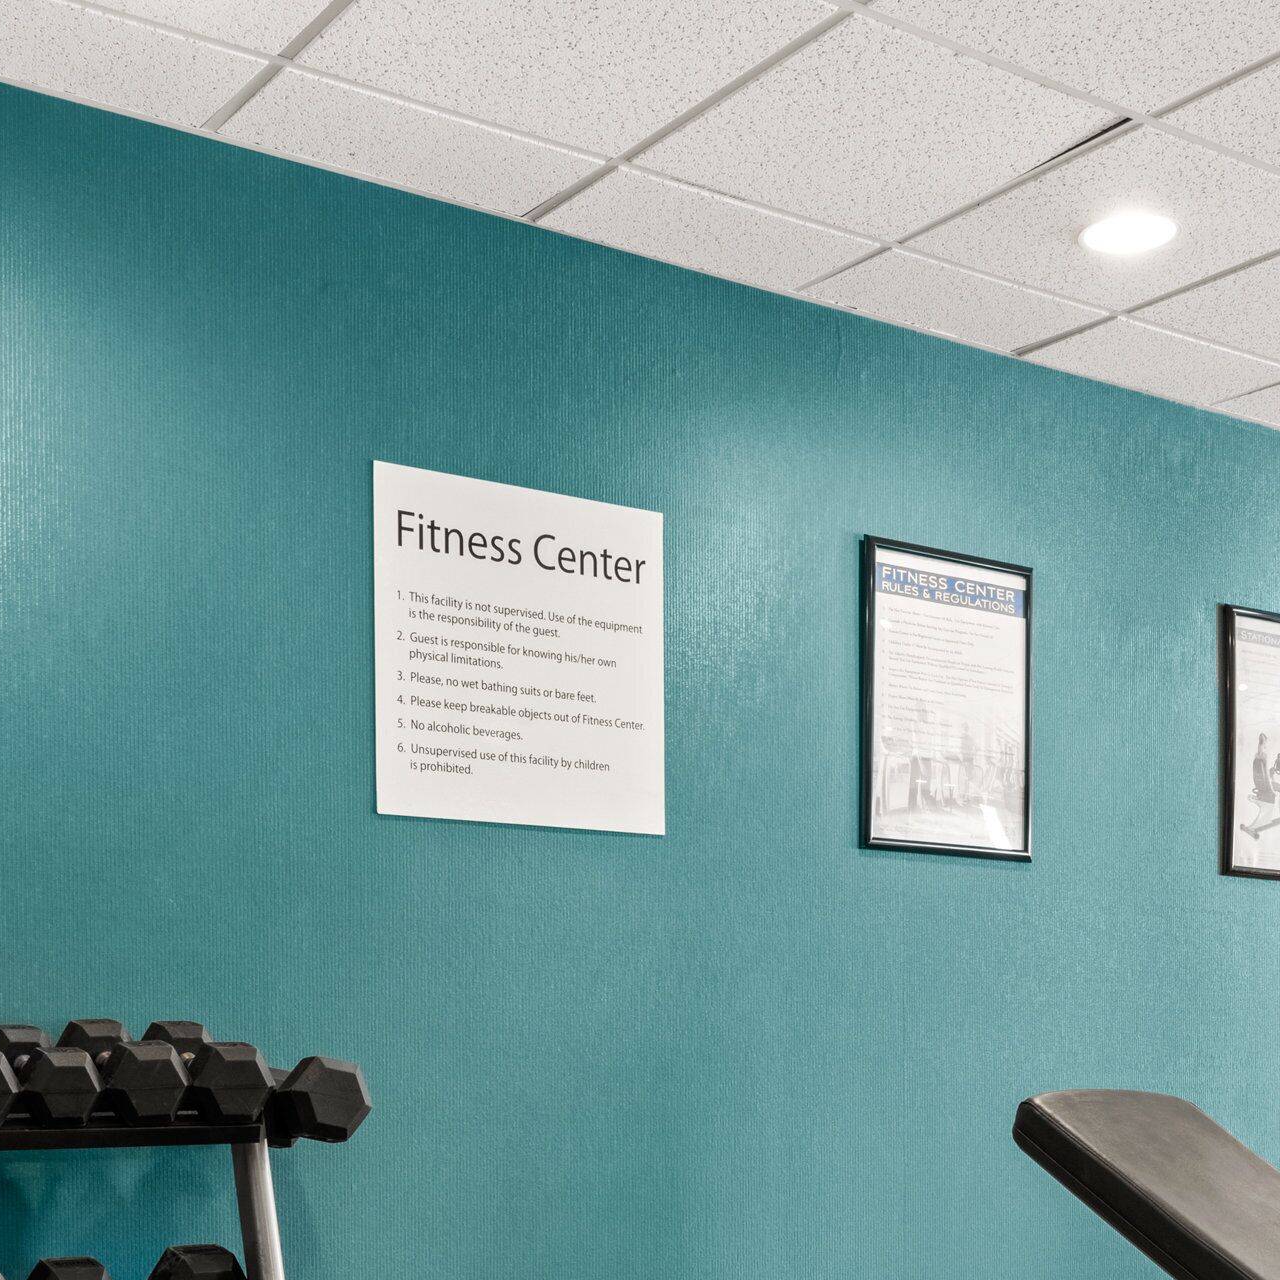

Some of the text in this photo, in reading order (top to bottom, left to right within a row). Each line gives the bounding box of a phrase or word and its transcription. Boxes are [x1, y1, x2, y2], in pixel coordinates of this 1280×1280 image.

[397, 509, 647, 585] Fitness Center
[882, 566, 1016, 602] FITNESS CENTER
[882, 581, 1016, 614] RULES & REGULATIONS
[397, 588, 643, 635] 1. This facility is not supervised. Use of the equipment
[408, 607, 561, 638] is the responsibility of the guest.
[396, 629, 617, 668] 2. Guest is responsible for knowing his/her own
[409, 648, 504, 670] physical limitations.
[397, 670, 597, 704] 3. Please, no wet bathing suits or bare feet.
[396, 694, 645, 731] 4. Please keep breakable objects out of Fitness Center.
[397, 717, 524, 742] 5. No alcoholic beverages.
[397, 742, 610, 772] 6. Unsupervised use of this facility by children
[410, 759, 474, 775] is prohibited.
